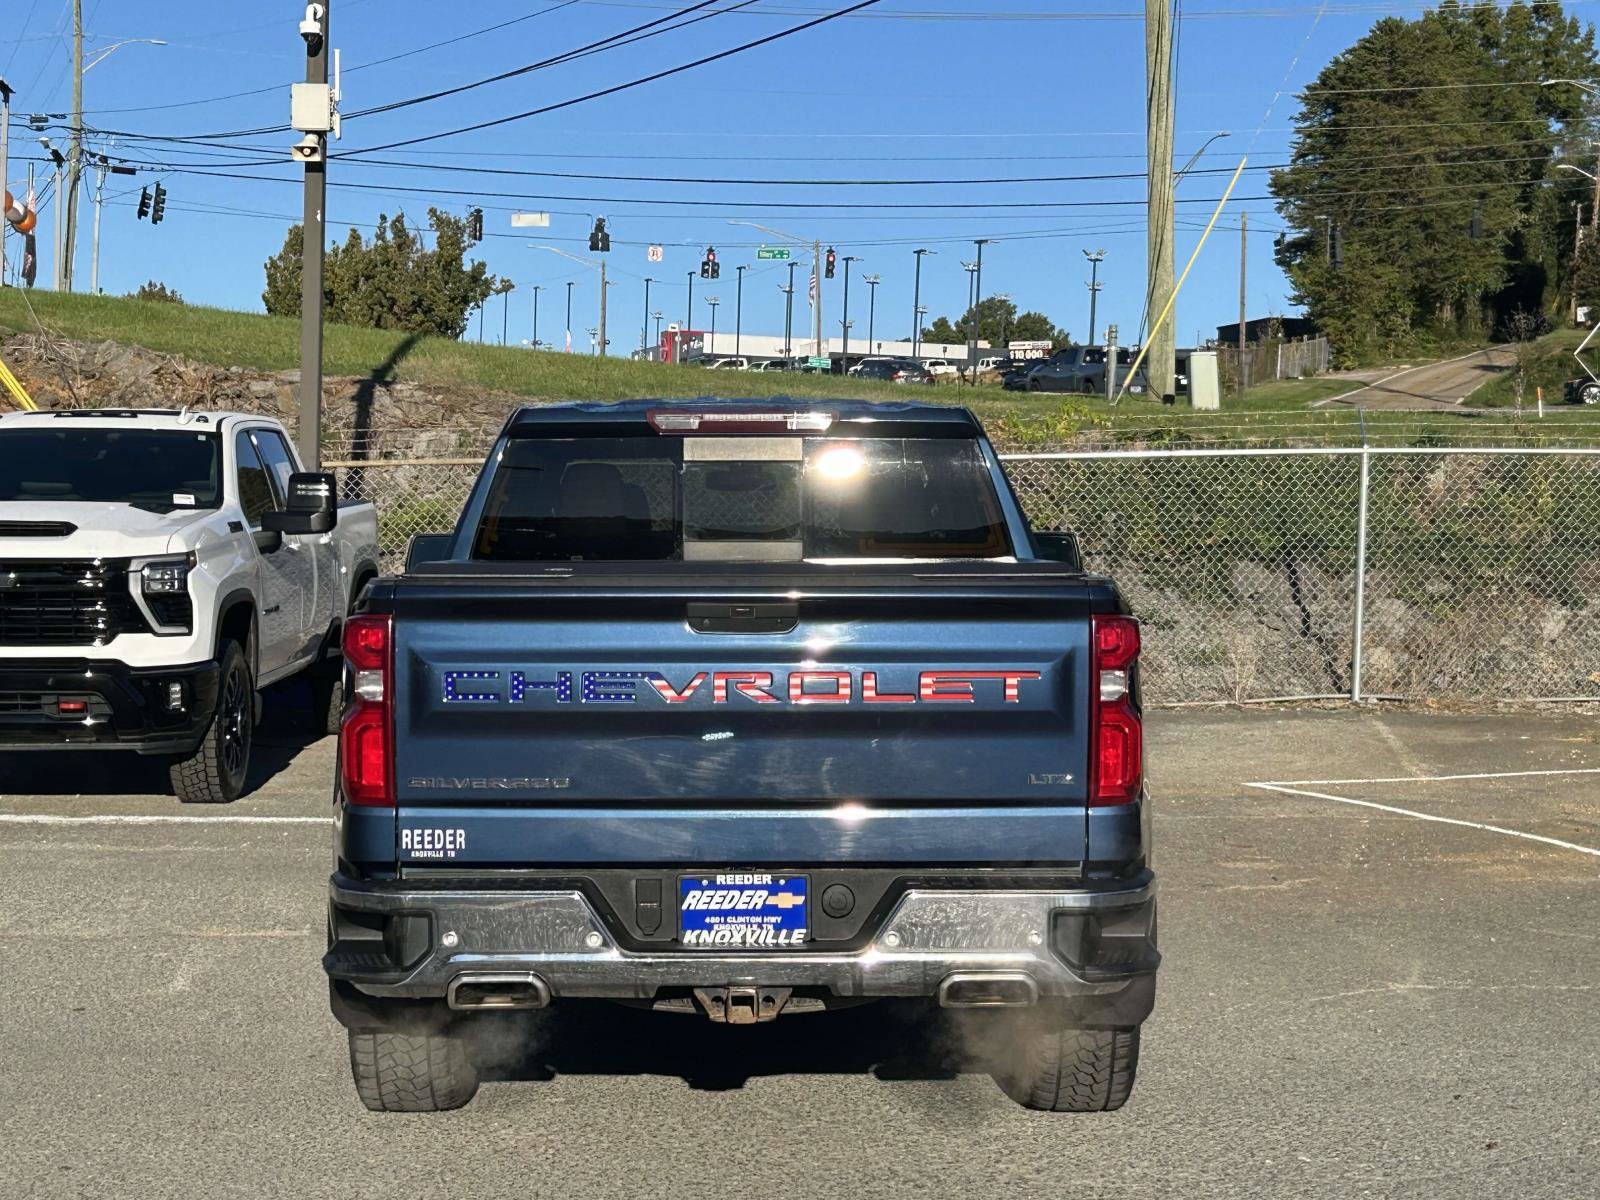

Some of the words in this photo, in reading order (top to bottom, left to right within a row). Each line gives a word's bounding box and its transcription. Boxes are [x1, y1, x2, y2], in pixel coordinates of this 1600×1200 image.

[443, 671, 1041, 704] CHEVROLET
[407, 777, 569, 789] SILVERADO
[402, 829, 466, 849] REEDER
[716, 874, 773, 885] REEDER
[681, 890, 769, 910] REEDER
[726, 916, 762, 924] CLINTON
[763, 916, 782, 924] HWY
[682, 928, 807, 944] KNOXVILLE
